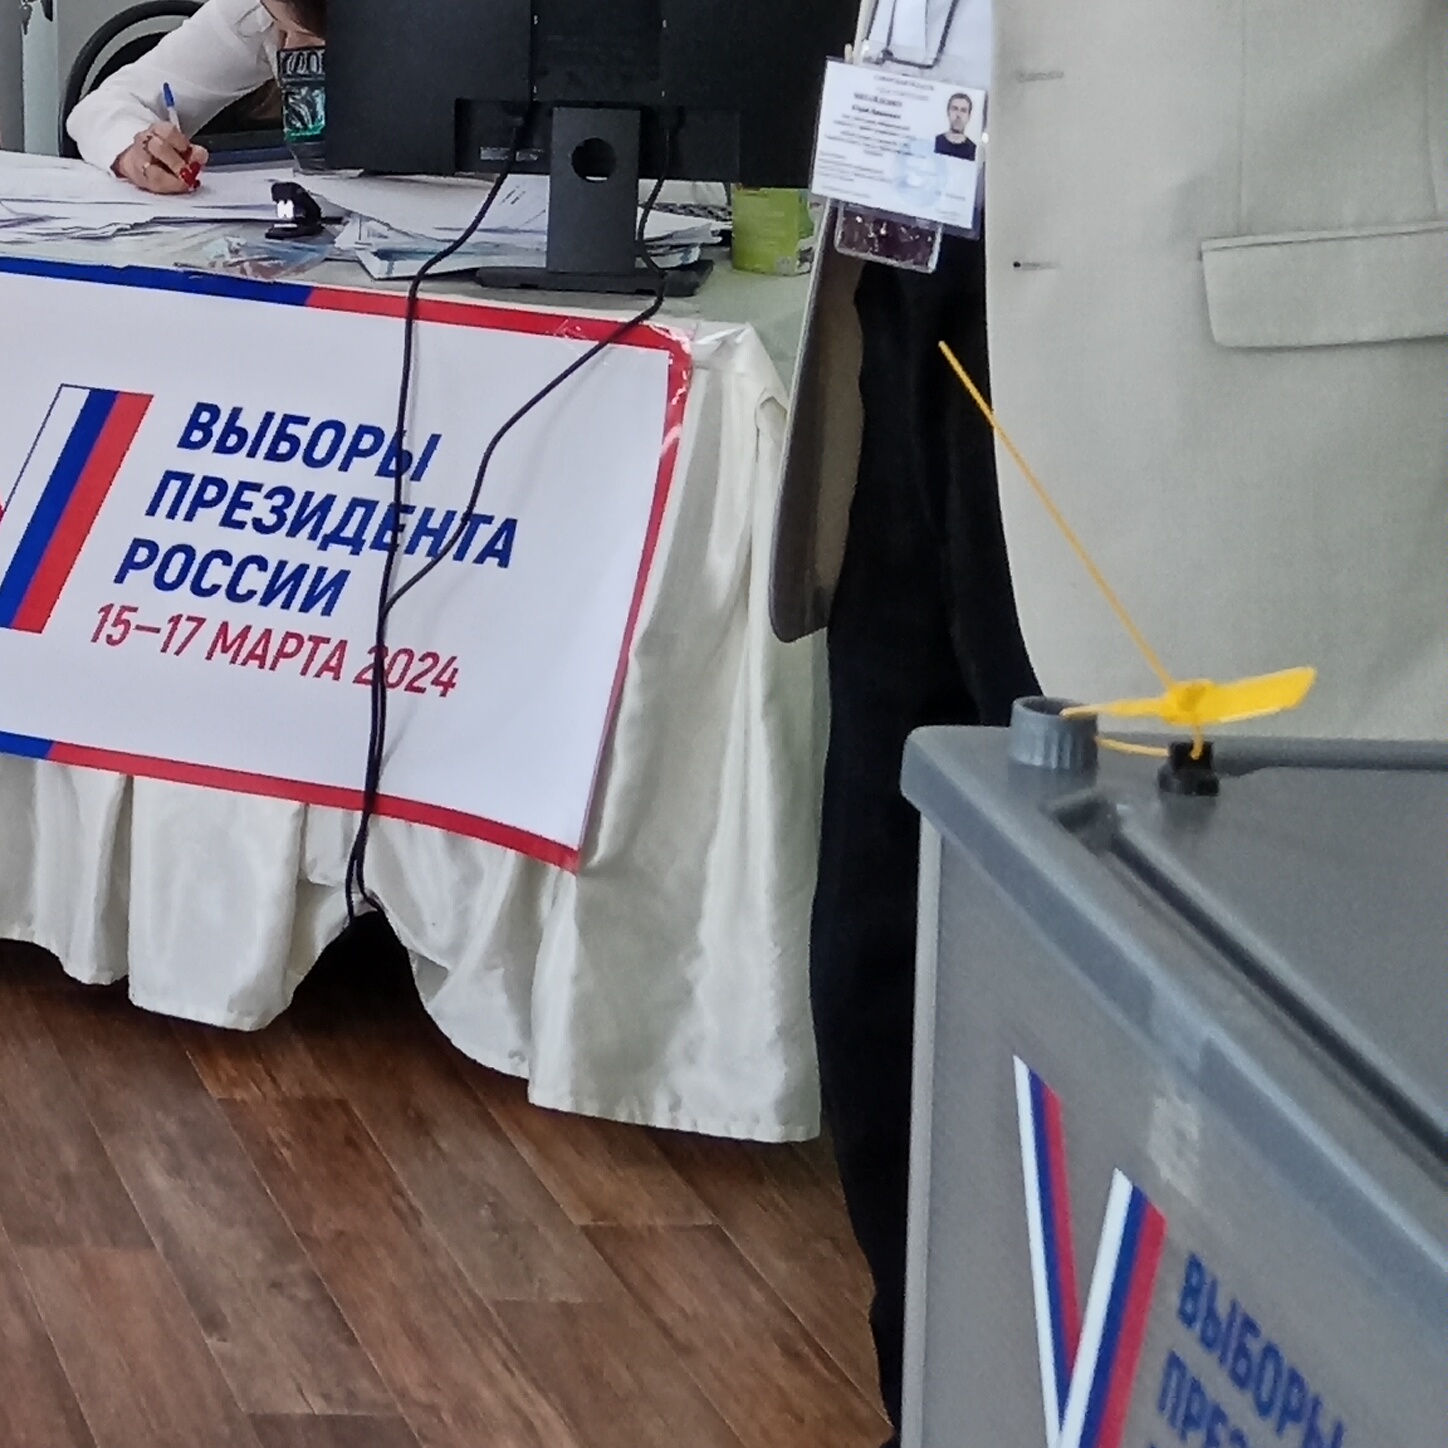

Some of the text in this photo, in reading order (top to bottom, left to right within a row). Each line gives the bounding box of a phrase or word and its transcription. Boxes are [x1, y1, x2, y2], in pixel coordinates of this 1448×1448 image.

[177, 401, 442, 483] ВЫБОРЫ
[145, 469, 518, 569] ПРЕЗИДЕНТА
[113, 537, 351, 617] РОССИИ
[204, 620, 348, 682] МАРТА
[353, 645, 460, 698] 2024
